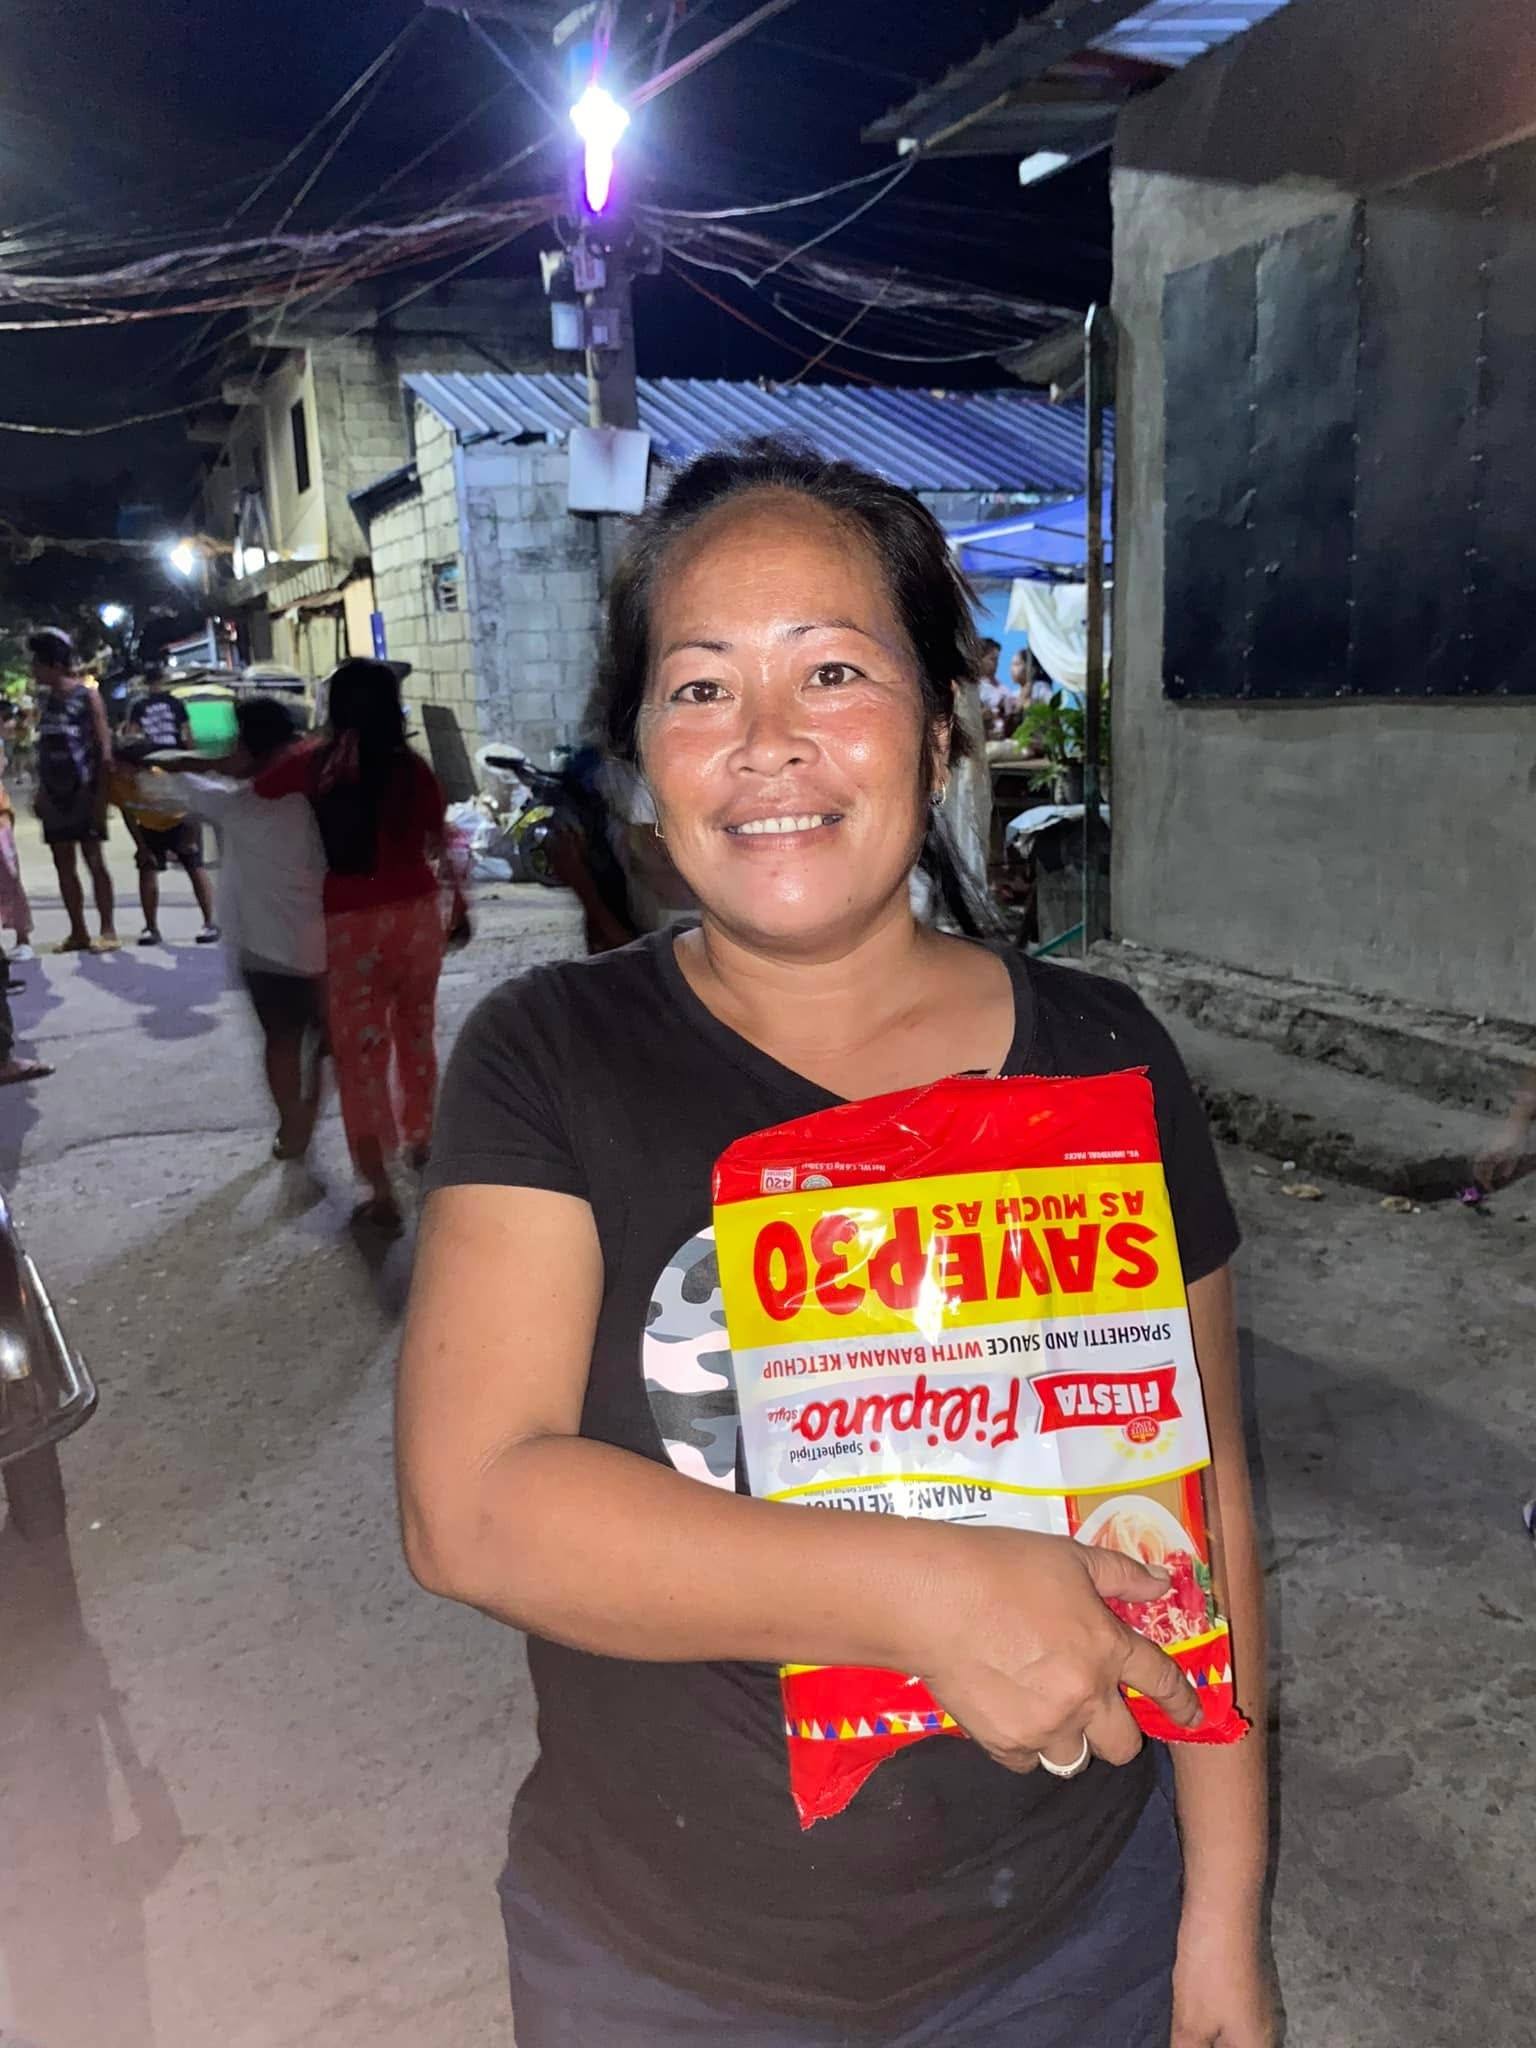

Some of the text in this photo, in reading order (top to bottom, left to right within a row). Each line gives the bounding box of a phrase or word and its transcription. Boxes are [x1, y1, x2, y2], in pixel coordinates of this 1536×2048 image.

[1063, 1151, 1087, 1161] PACKS
[765, 1176, 792, 1189] 420
[932, 1190, 1144, 1230] AS MUCH AS
[933, 1221, 1159, 1304] SAVE
[762, 1323, 1171, 1379] SPAGHETTI AND SAUCE WITH BANANA KETCHUP
[767, 1374, 1020, 1453] Filipino style
[1053, 1380, 1160, 1416] FIESTA
[789, 1440, 864, 1463] SpaghetTipid
[805, 1483, 993, 1515] BANAN KETCH
